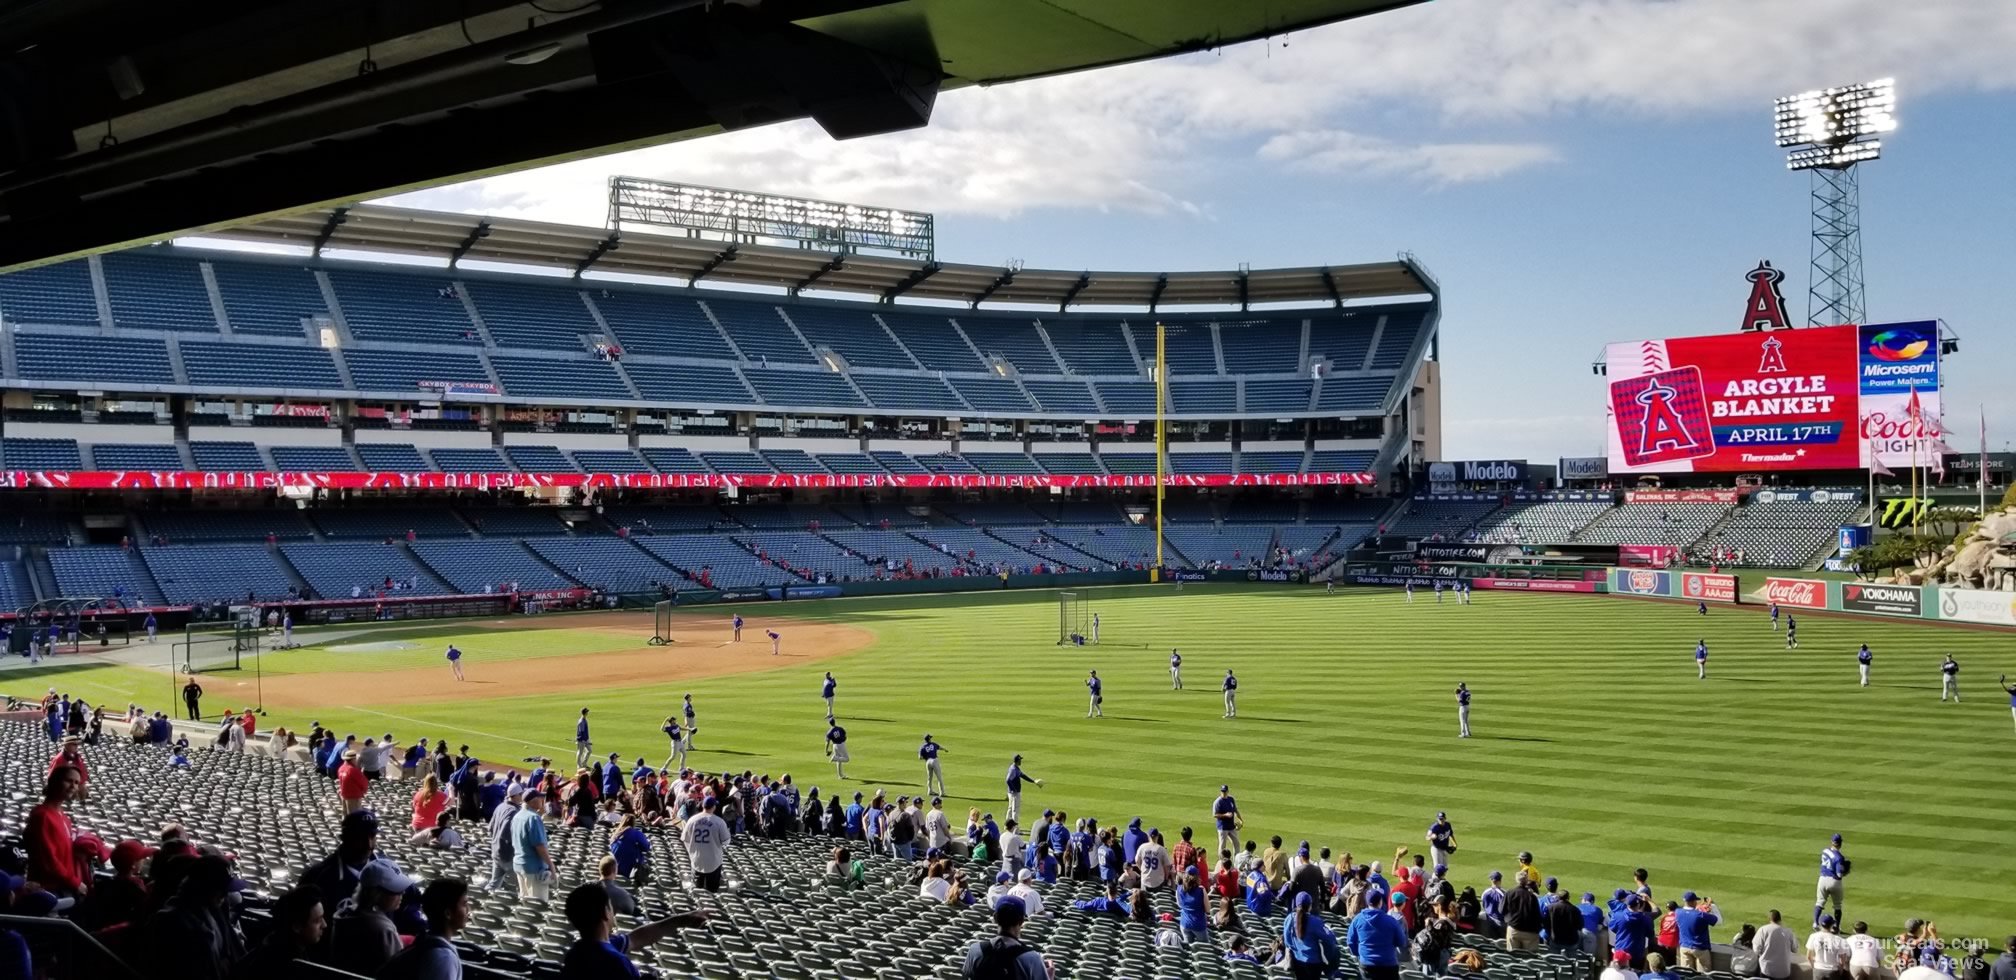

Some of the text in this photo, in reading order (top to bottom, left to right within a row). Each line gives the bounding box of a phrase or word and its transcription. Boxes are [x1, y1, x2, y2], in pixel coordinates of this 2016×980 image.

[1724, 375, 1826, 398] ARGYLE
[1869, 379, 1895, 387] Power
[1712, 396, 1835, 418] BLANKET
[1728, 425, 1832, 443] APRIL 17TH
[1741, 453, 1797, 463] Thermador
[1950, 459, 2004, 469] TEAM SORE
[1464, 461, 1517, 480] Modelo
[1567, 460, 1601, 474] Modelo
[1420, 546, 1486, 558] NITTOTIRE.COM
[1175, 573, 1205, 581] Fnatics
[1260, 570, 1288, 581] Modelo
[1767, 580, 1814, 605] Coca-Cola
[1862, 587, 1915, 602] YOKOHAMA
[694, 829, 710, 843] 22
